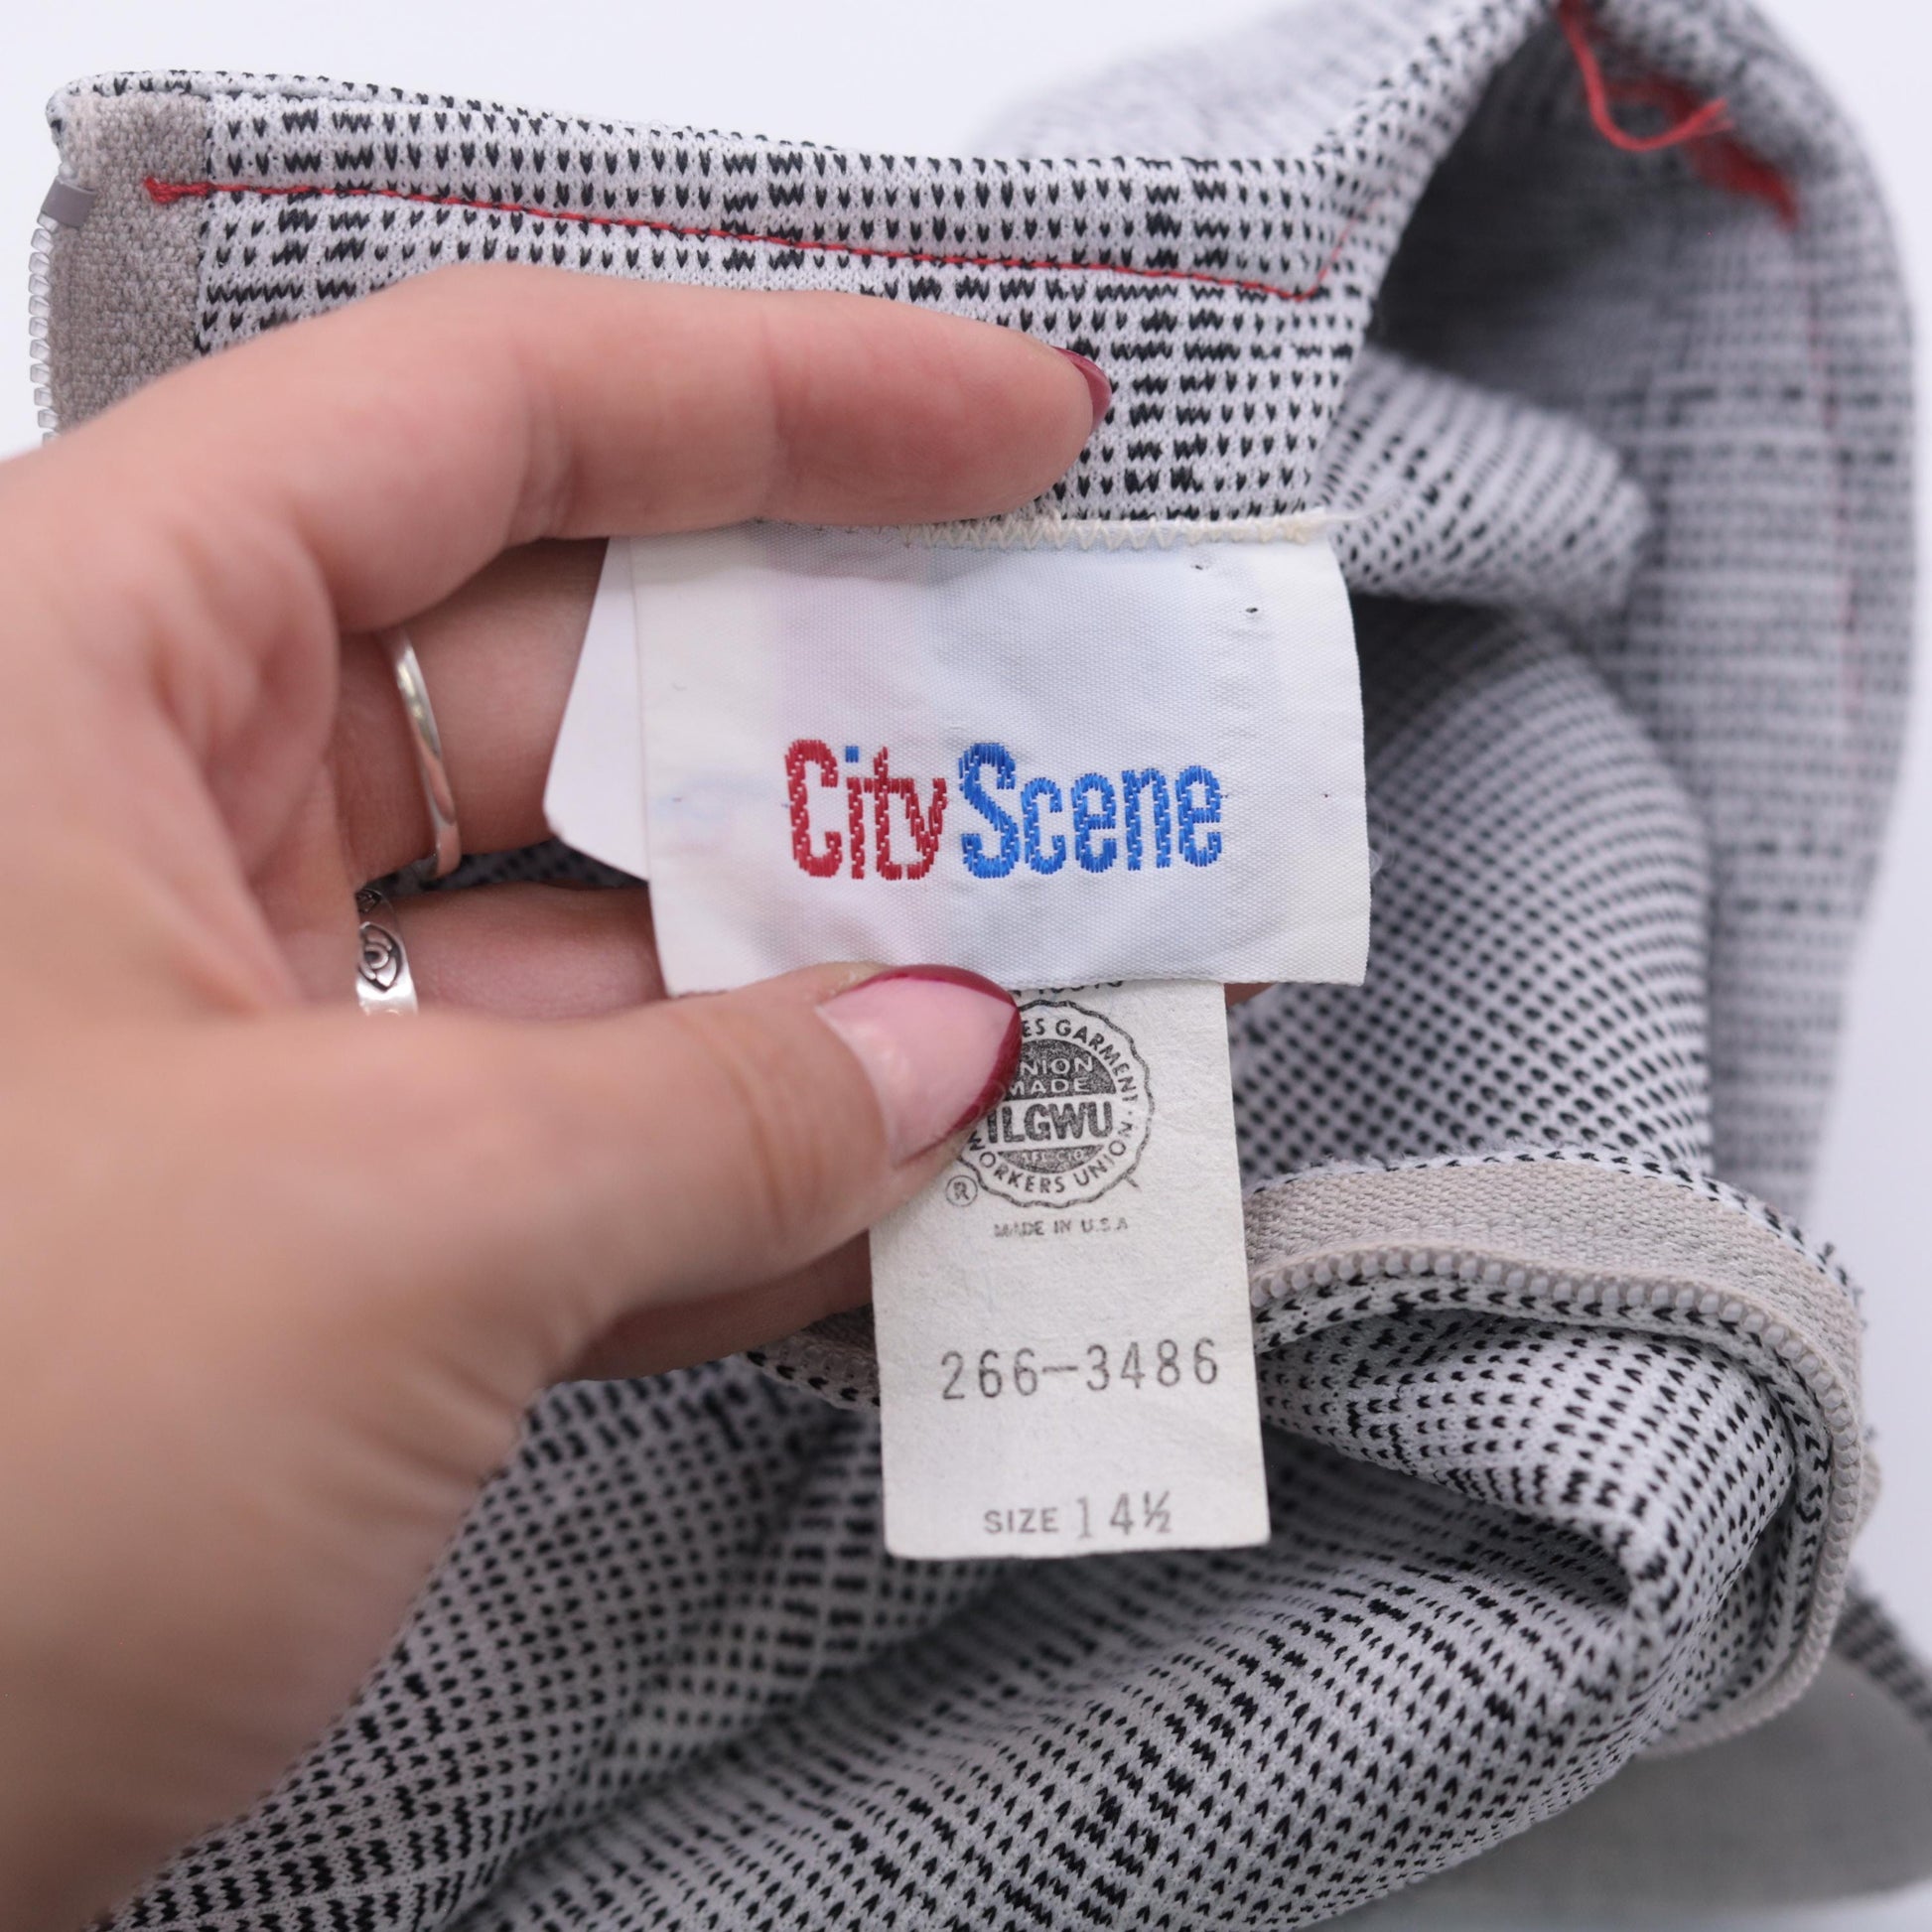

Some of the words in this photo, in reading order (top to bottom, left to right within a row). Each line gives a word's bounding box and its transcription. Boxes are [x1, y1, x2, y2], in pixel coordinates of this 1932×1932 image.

[784, 738, 948, 881] City
[958, 742, 1223, 880] Scene
[1021, 1055, 1094, 1075] NION
[1055, 1019, 1138, 1102] GARMENT
[987, 1101, 1115, 1145] ILGWU
[1073, 1121, 1134, 1186] UNION
[994, 1220, 1045, 1238] MADE
[1054, 1219, 1073, 1235] IN
[983, 1506, 1060, 1535] SIZE
